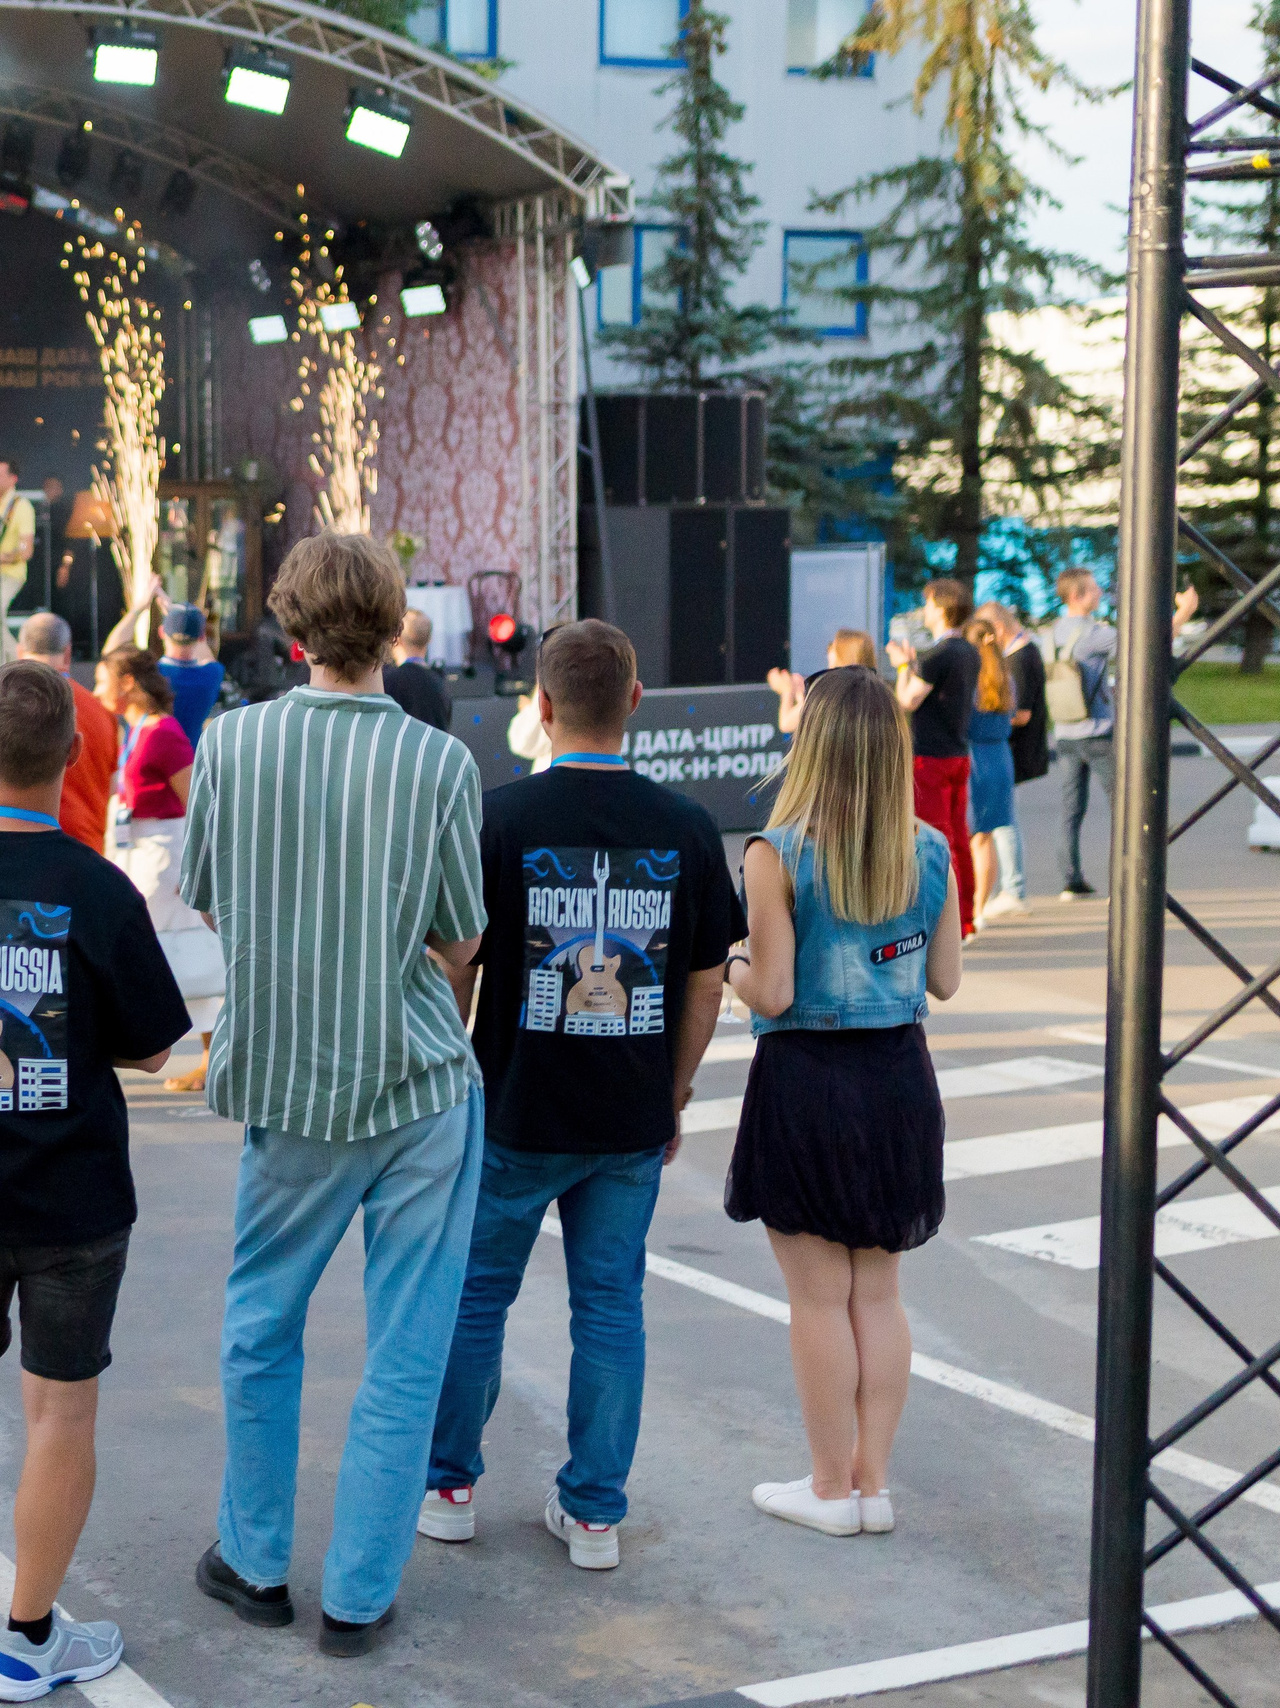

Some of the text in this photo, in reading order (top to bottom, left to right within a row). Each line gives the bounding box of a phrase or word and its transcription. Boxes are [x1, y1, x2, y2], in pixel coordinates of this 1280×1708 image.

[633, 723, 775, 758] ДАТА-ЦЕНТР
[528, 886, 671, 930] ROCKIN' RUSSIA
